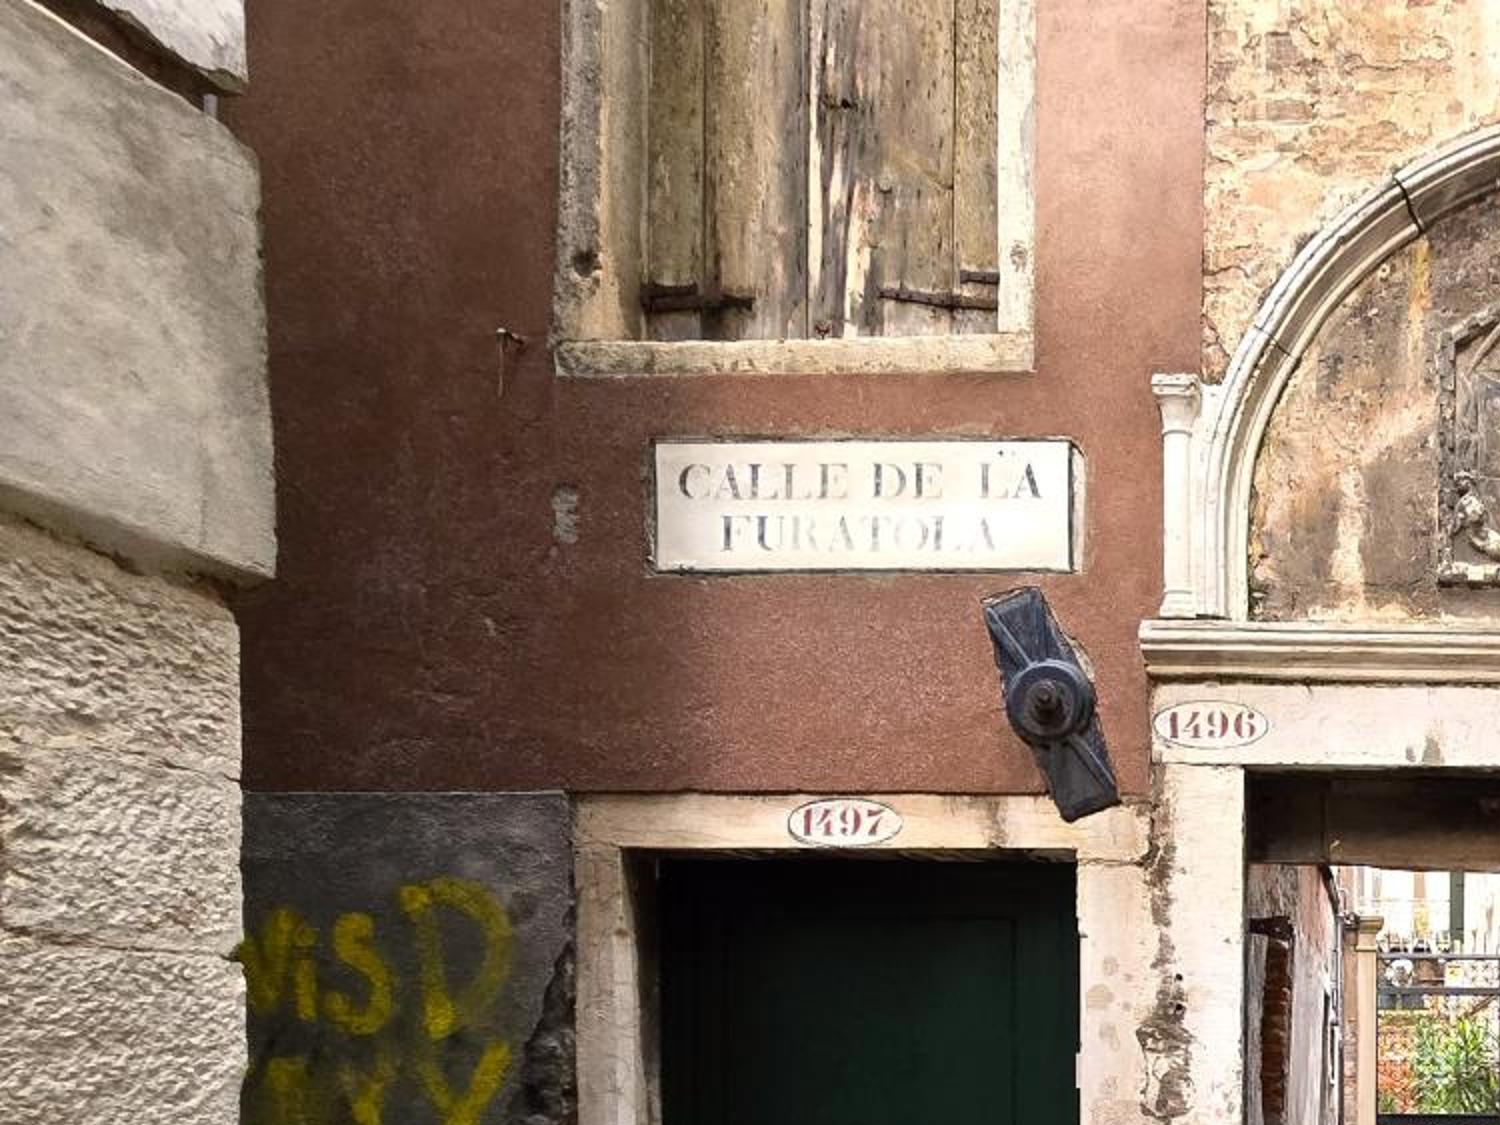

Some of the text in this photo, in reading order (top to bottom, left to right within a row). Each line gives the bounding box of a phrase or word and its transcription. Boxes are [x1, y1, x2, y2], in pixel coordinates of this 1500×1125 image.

[677, 461, 1043, 500] CALLE DE LA
[720, 514, 997, 553] FURATOLA
[1169, 710, 1256, 739] 1496
[803, 807, 886, 837] 1497
